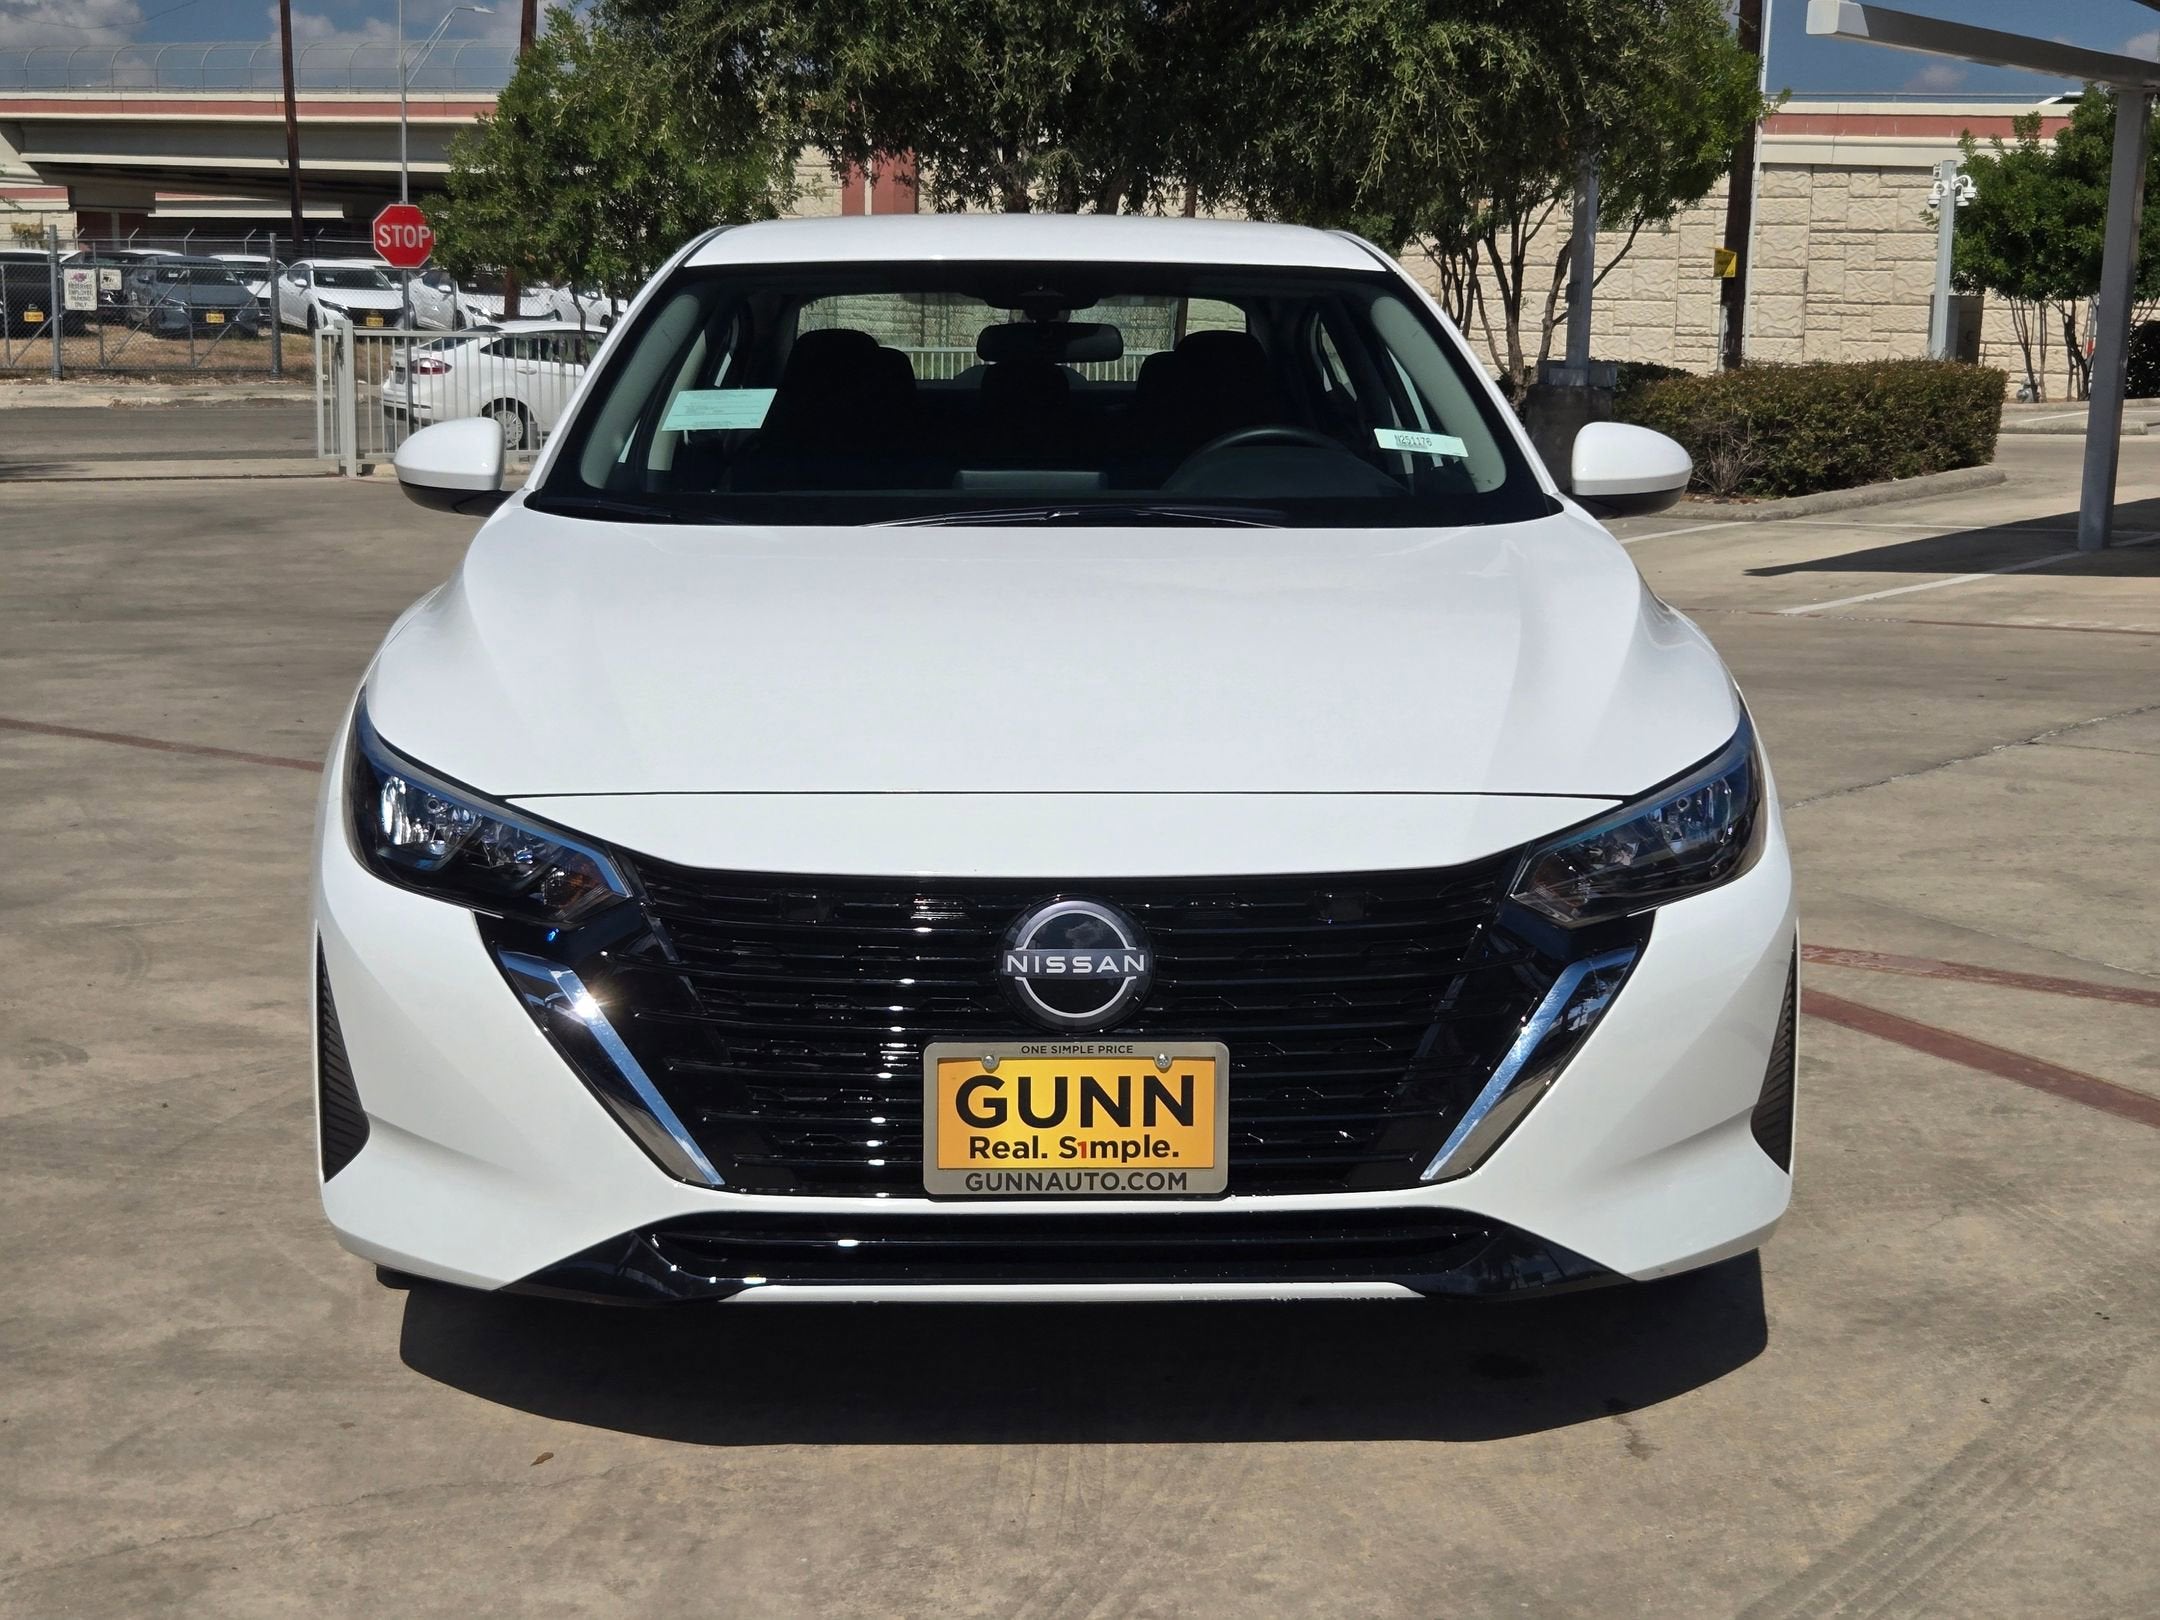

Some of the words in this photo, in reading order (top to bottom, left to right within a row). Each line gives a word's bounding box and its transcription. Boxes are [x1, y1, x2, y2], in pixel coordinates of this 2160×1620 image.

[378, 225, 431, 248] STOP
[1007, 954, 1145, 974] NISSAN
[1021, 1045, 1049, 1054] ONE
[1051, 1045, 1096, 1054] SIMPLE
[1098, 1045, 1133, 1054] PRICE
[955, 1074, 1195, 1129] GUNN
[969, 1135, 1048, 1159] Real.
[965, 1171, 1187, 1192] GUNNAUTO.COM
